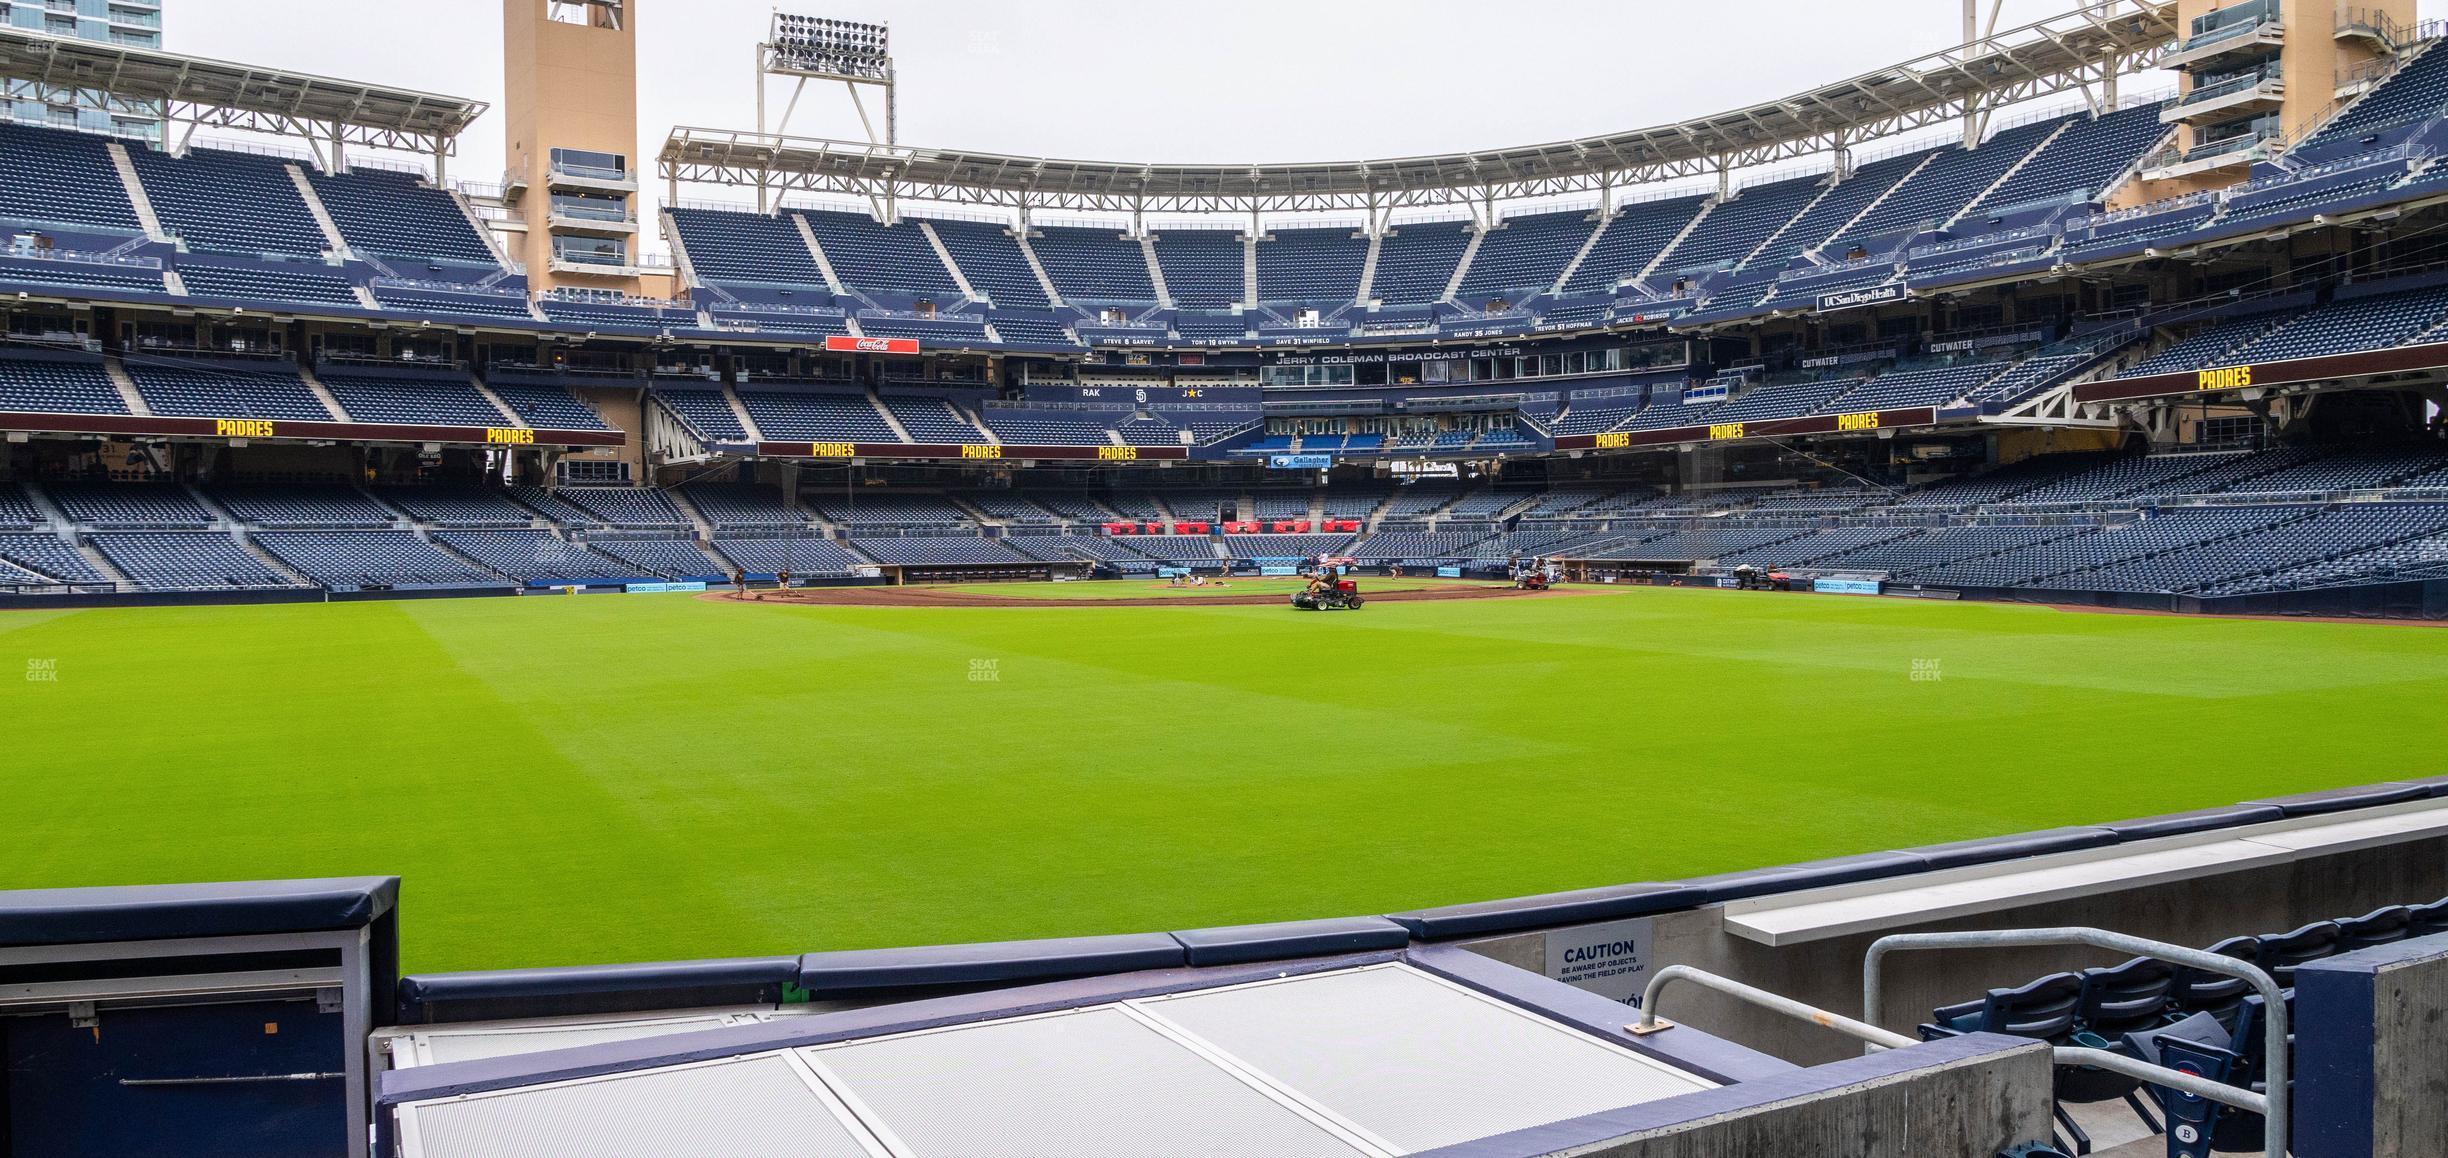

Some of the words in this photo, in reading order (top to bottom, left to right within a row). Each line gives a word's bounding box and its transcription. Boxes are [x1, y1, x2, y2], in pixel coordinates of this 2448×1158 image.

[1643, 312, 1670, 321] ROBINSON
[1566, 321, 1593, 329] HOFFMAN
[1208, 338, 1217, 346] 19
[1930, 339, 1973, 353] CUTWATER
[1276, 356, 1316, 365] JERRY
[1322, 354, 1384, 364] COLEMAN
[1389, 351, 1466, 362] BROADCAST
[1471, 347, 1521, 358] CENTER
[1802, 356, 1838, 368] CUTWATER
[2199, 366, 2251, 390] PADRES
[1082, 389, 1100, 397] RAK
[217, 419, 273, 437] PADRES
[1837, 412, 1878, 430] PADRES
[487, 428, 533, 445] PADRES
[1709, 423, 1744, 440] PADRES
[1596, 432, 1629, 448] PADRES
[812, 443, 855, 457] PADRES
[962, 444, 1001, 459] PADRES
[1098, 447, 1137, 460] PADRES
[1294, 456, 1329, 464] Gallagher
[627, 585, 647, 593] petco
[668, 584, 687, 592] petco
[1564, 940, 1635, 963] CAUTION
[1562, 966, 1570, 975] BE
[1571, 963, 1596, 973] AWARE
[1597, 961, 1606, 969] OF
[1608, 956, 1637, 967] OBJECTS
[1584, 971, 1597, 979] THE
[1598, 968, 1616, 978] FIELD
[1618, 967, 1626, 975] OF
[1628, 964, 1645, 973] PLAY
[2183, 1130, 2191, 1139] B
